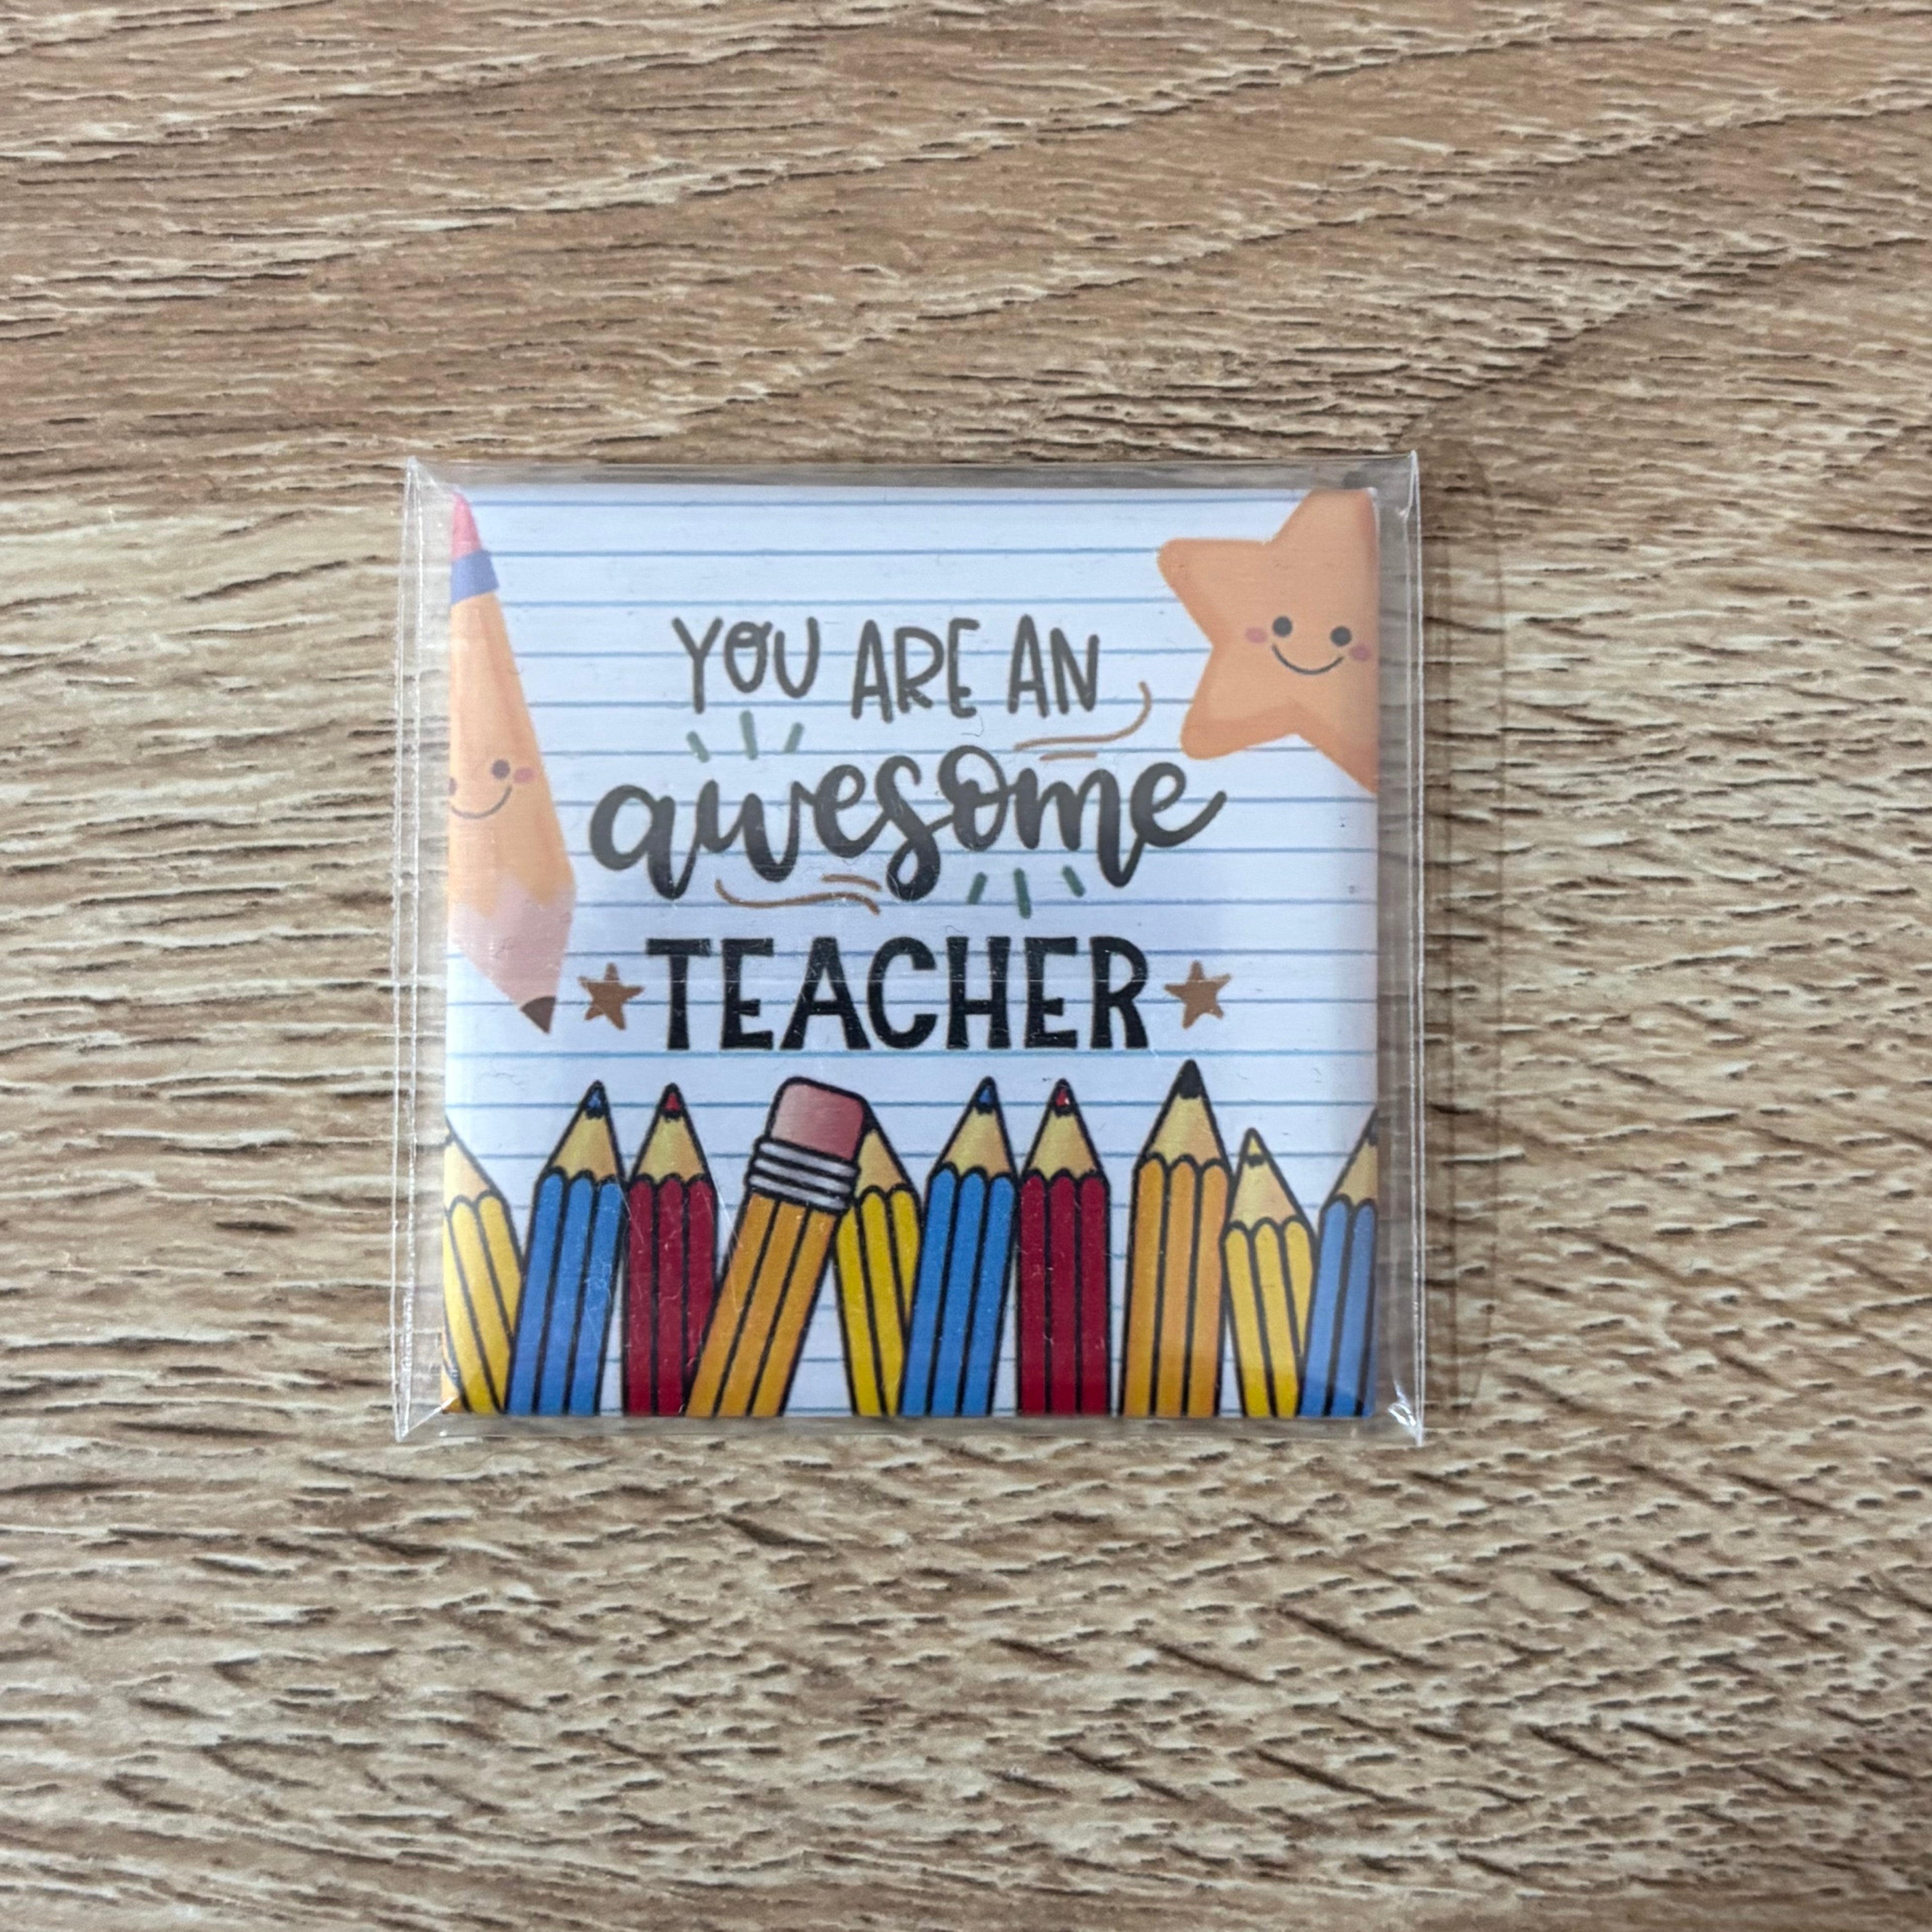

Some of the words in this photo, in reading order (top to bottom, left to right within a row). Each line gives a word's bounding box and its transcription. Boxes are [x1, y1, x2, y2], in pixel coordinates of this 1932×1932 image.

[672, 615, 821, 715] YOU
[850, 617, 980, 723] ARE
[1008, 614, 1100, 718] AN
[589, 745, 1228, 902] awesome
[645, 935, 1150, 1051] TEACHER
